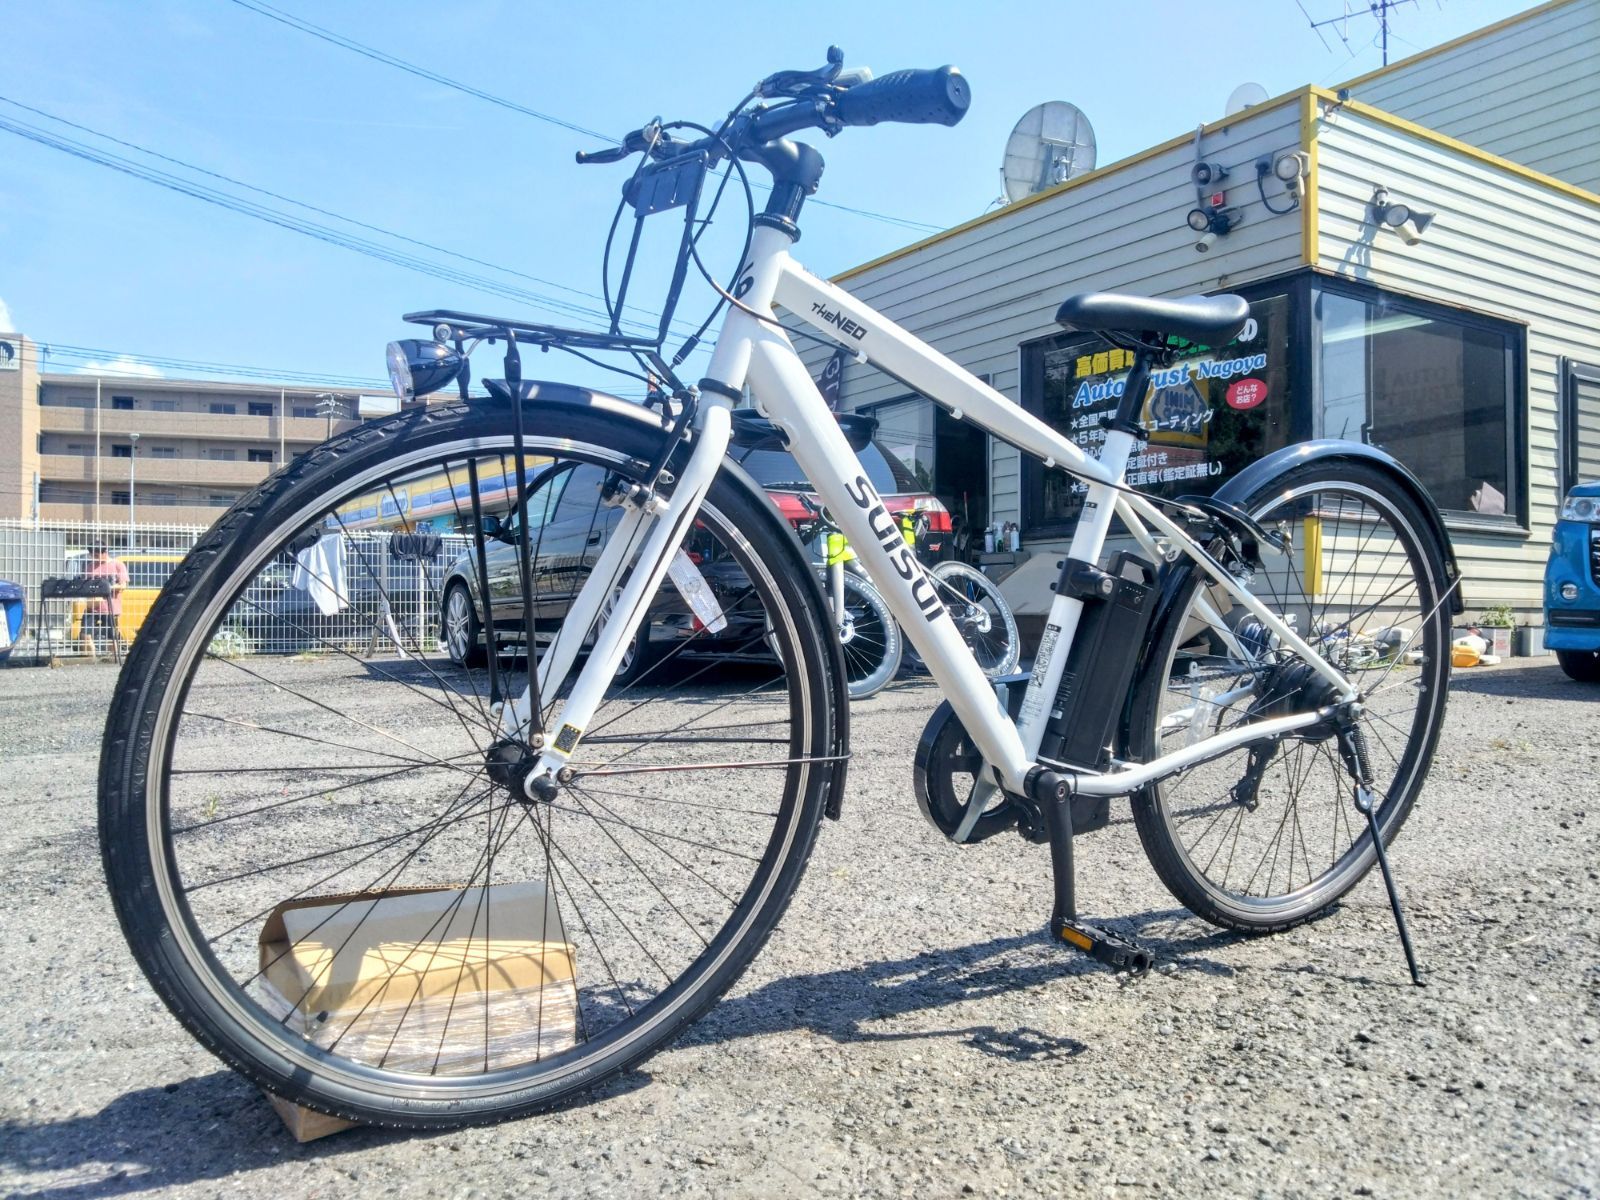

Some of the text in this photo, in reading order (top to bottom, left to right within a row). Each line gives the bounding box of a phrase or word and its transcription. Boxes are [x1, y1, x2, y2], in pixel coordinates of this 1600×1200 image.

[1072, 354, 1266, 408] Auto ust Nagoya
[1236, 384, 1258, 395] どんな
[844, 475, 946, 623] SUISUI
